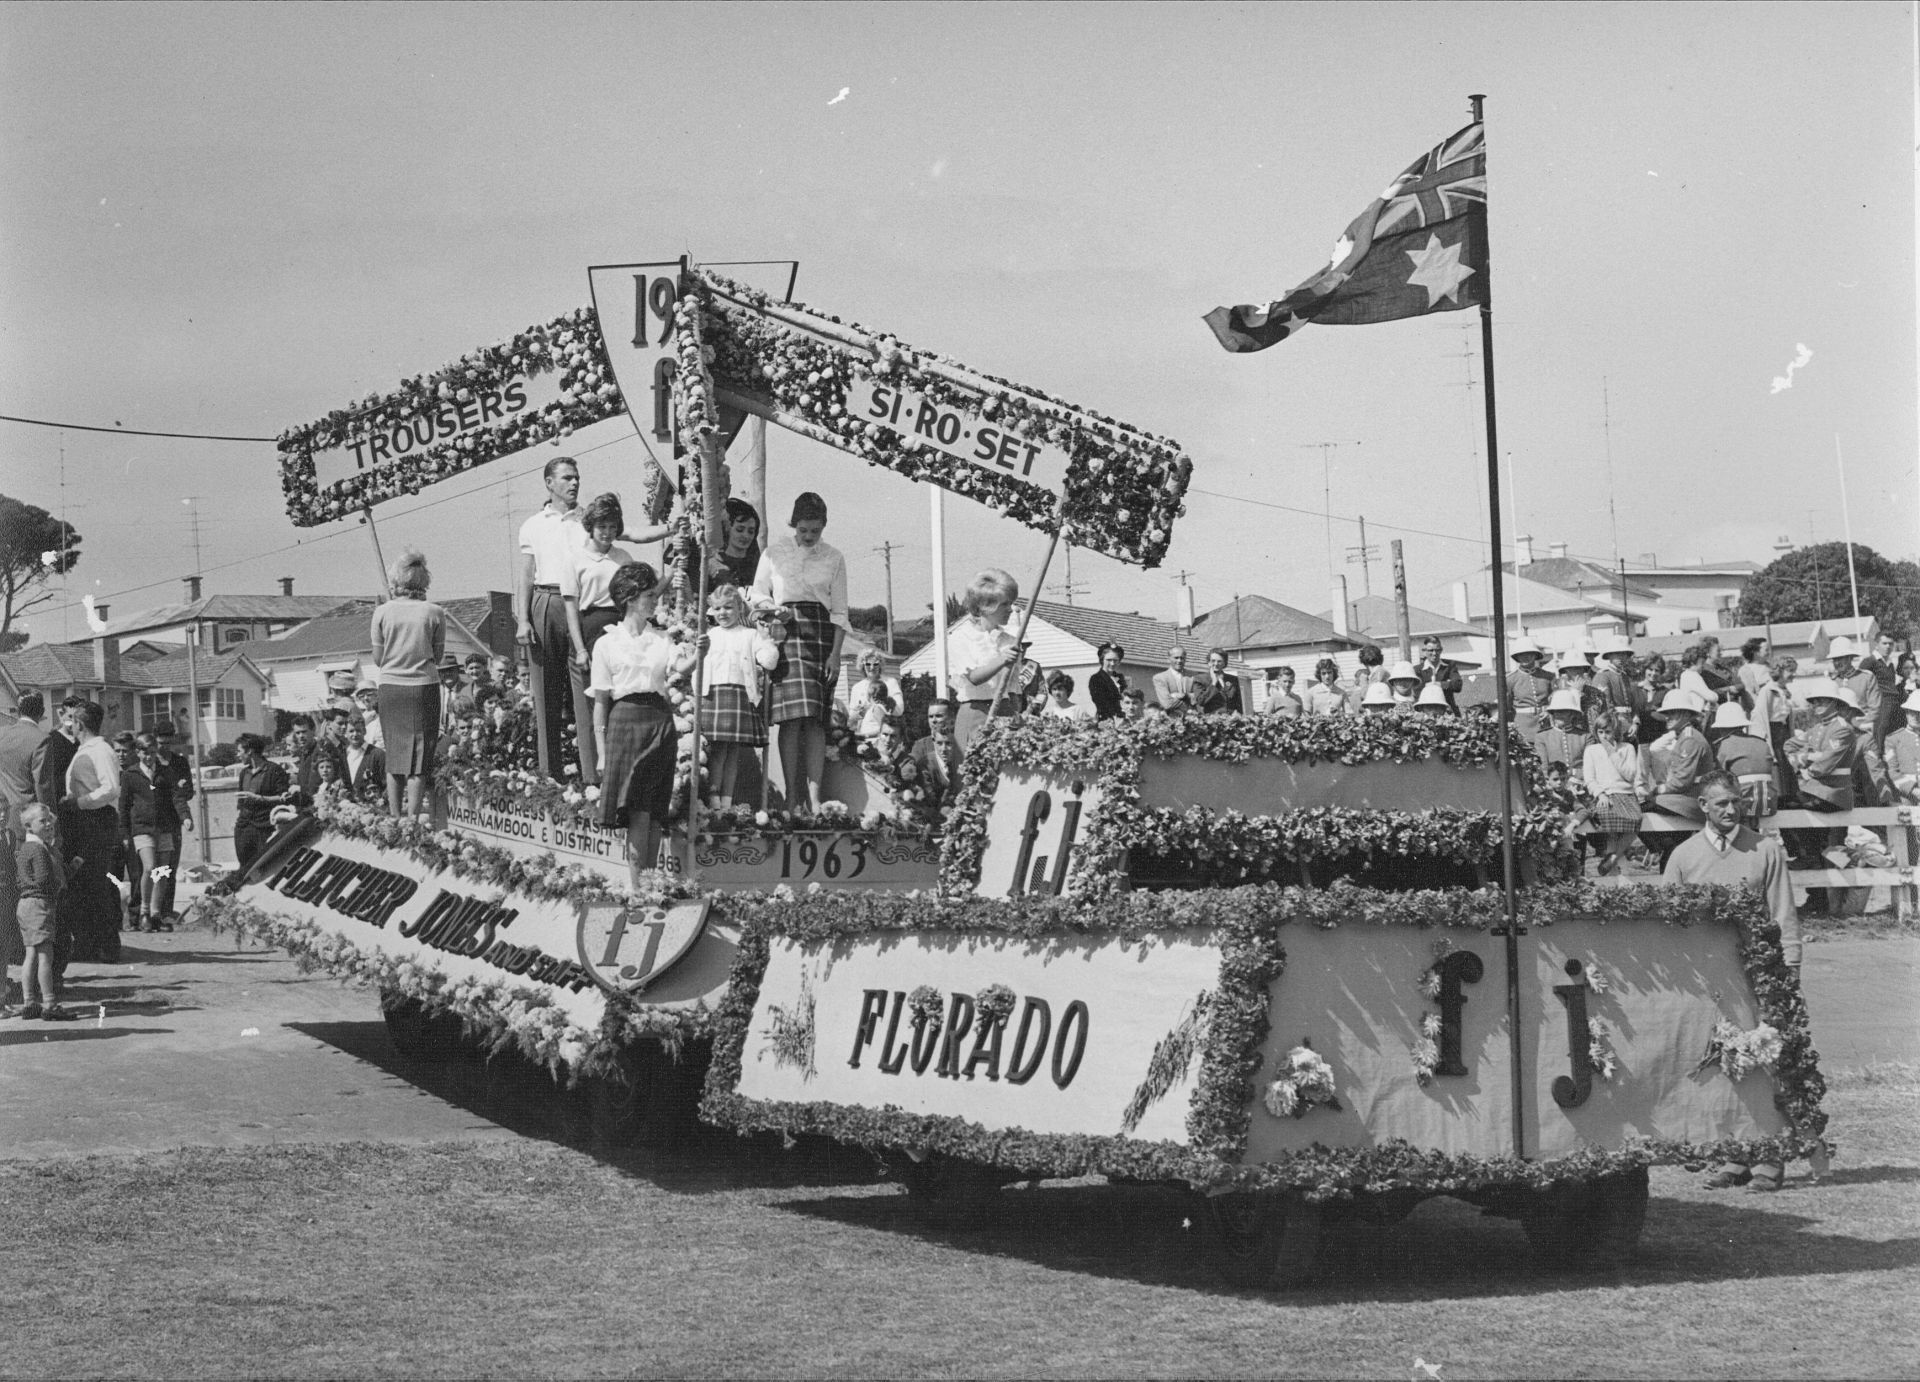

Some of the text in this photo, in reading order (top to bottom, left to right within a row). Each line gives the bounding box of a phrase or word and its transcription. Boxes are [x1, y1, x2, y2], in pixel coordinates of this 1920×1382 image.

[347, 382, 527, 469] TROUSERS
[447, 806, 536, 839] WARRNAMBOOL
[555, 829, 611, 857] DISTRICT
[574, 815, 626, 840] FASHIO
[780, 837, 867, 880] 1963
[265, 847, 419, 930] FLETCHER
[399, 888, 520, 960] JONES
[481, 940, 541, 976] AND
